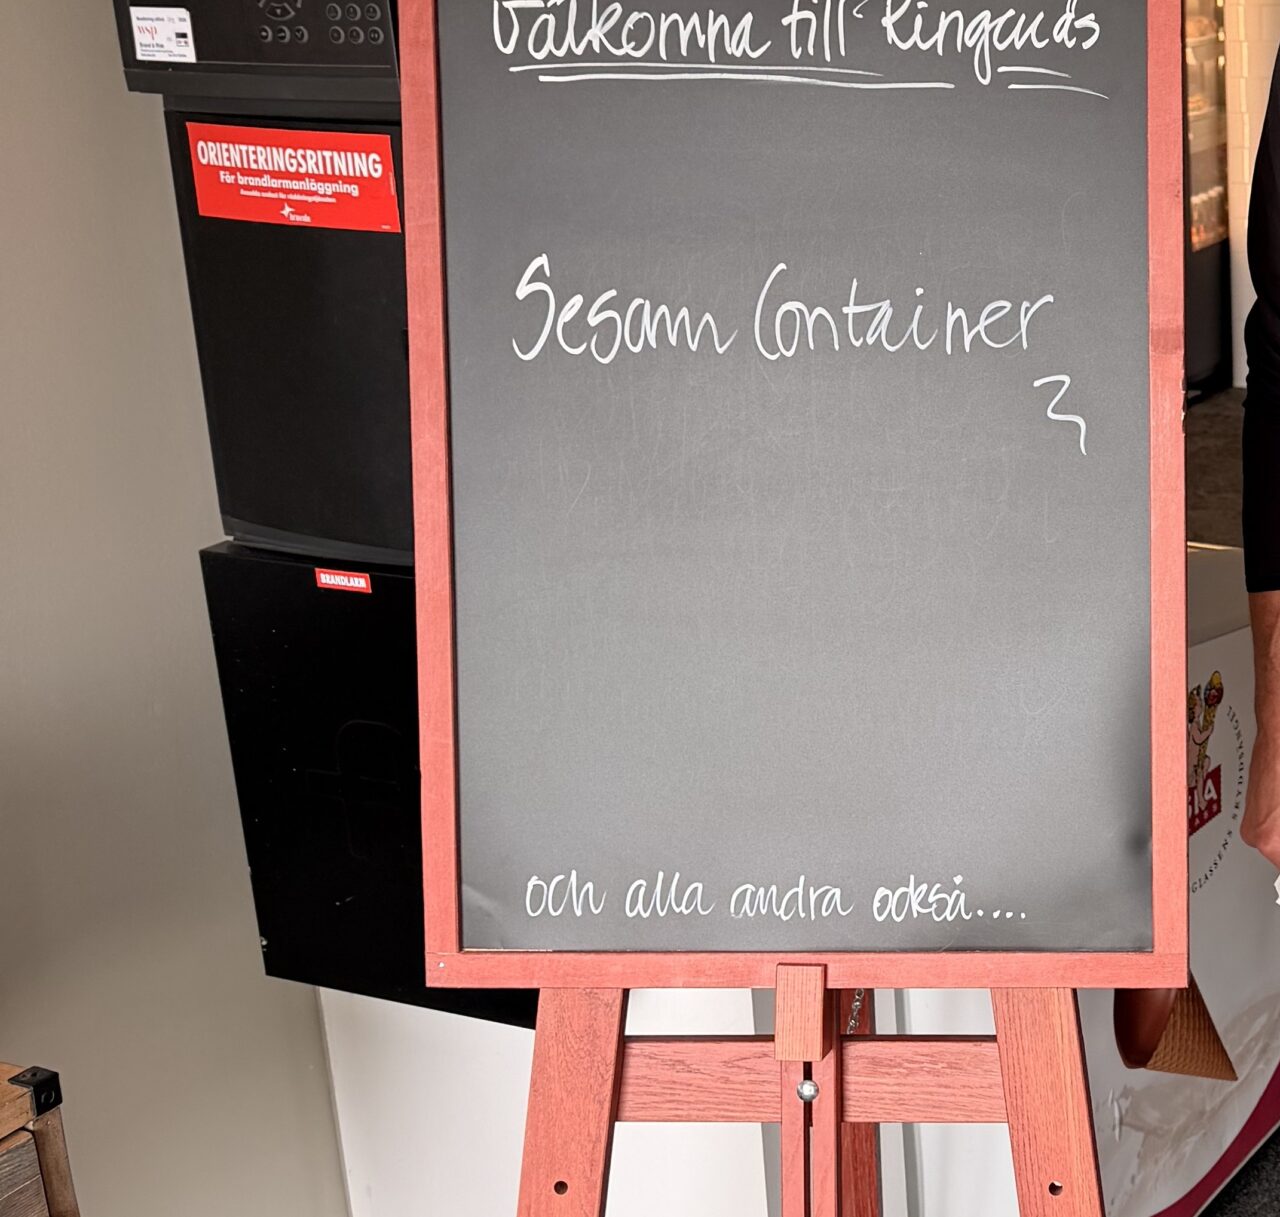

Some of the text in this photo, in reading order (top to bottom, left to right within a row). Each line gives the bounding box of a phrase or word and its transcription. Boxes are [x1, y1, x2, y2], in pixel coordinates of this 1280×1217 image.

[197, 140, 383, 178] ORIENTERINGSRITNING
[219, 171, 235, 184] För
[237, 174, 359, 196] brandlarmanläggning
[754, 263, 1054, 360] Container
[525, 869, 606, 918] och
[625, 871, 716, 919] alla
[729, 875, 855, 921] andra
